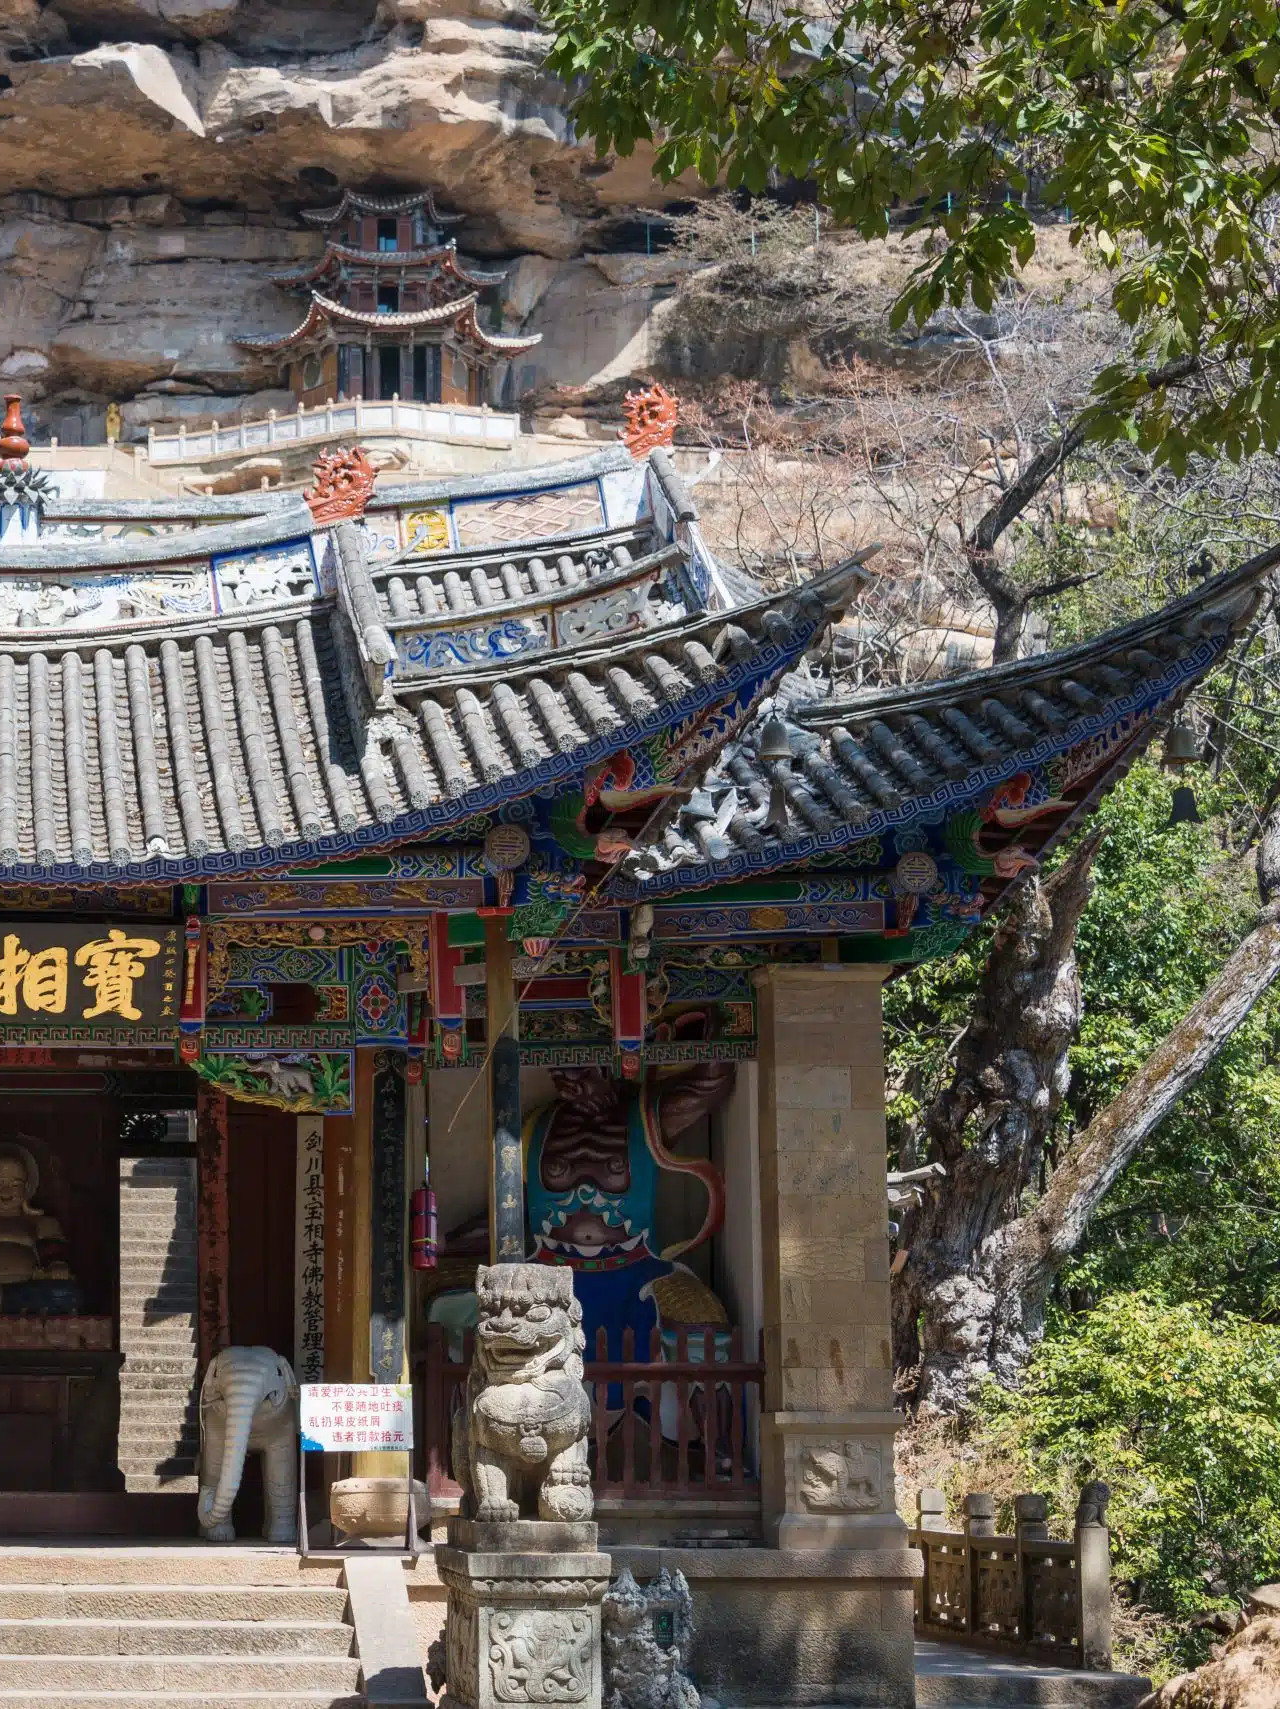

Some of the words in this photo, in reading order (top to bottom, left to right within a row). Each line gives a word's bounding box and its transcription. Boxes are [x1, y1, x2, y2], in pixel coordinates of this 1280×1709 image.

[307, 1386, 393, 1398] 请爱护公共卫生
[332, 1400, 404, 1412] 不要随地吐痰
[308, 1415, 380, 1428] 乱扔果皮纸屑
[332, 1430, 405, 1443] 违者罚款拾元
